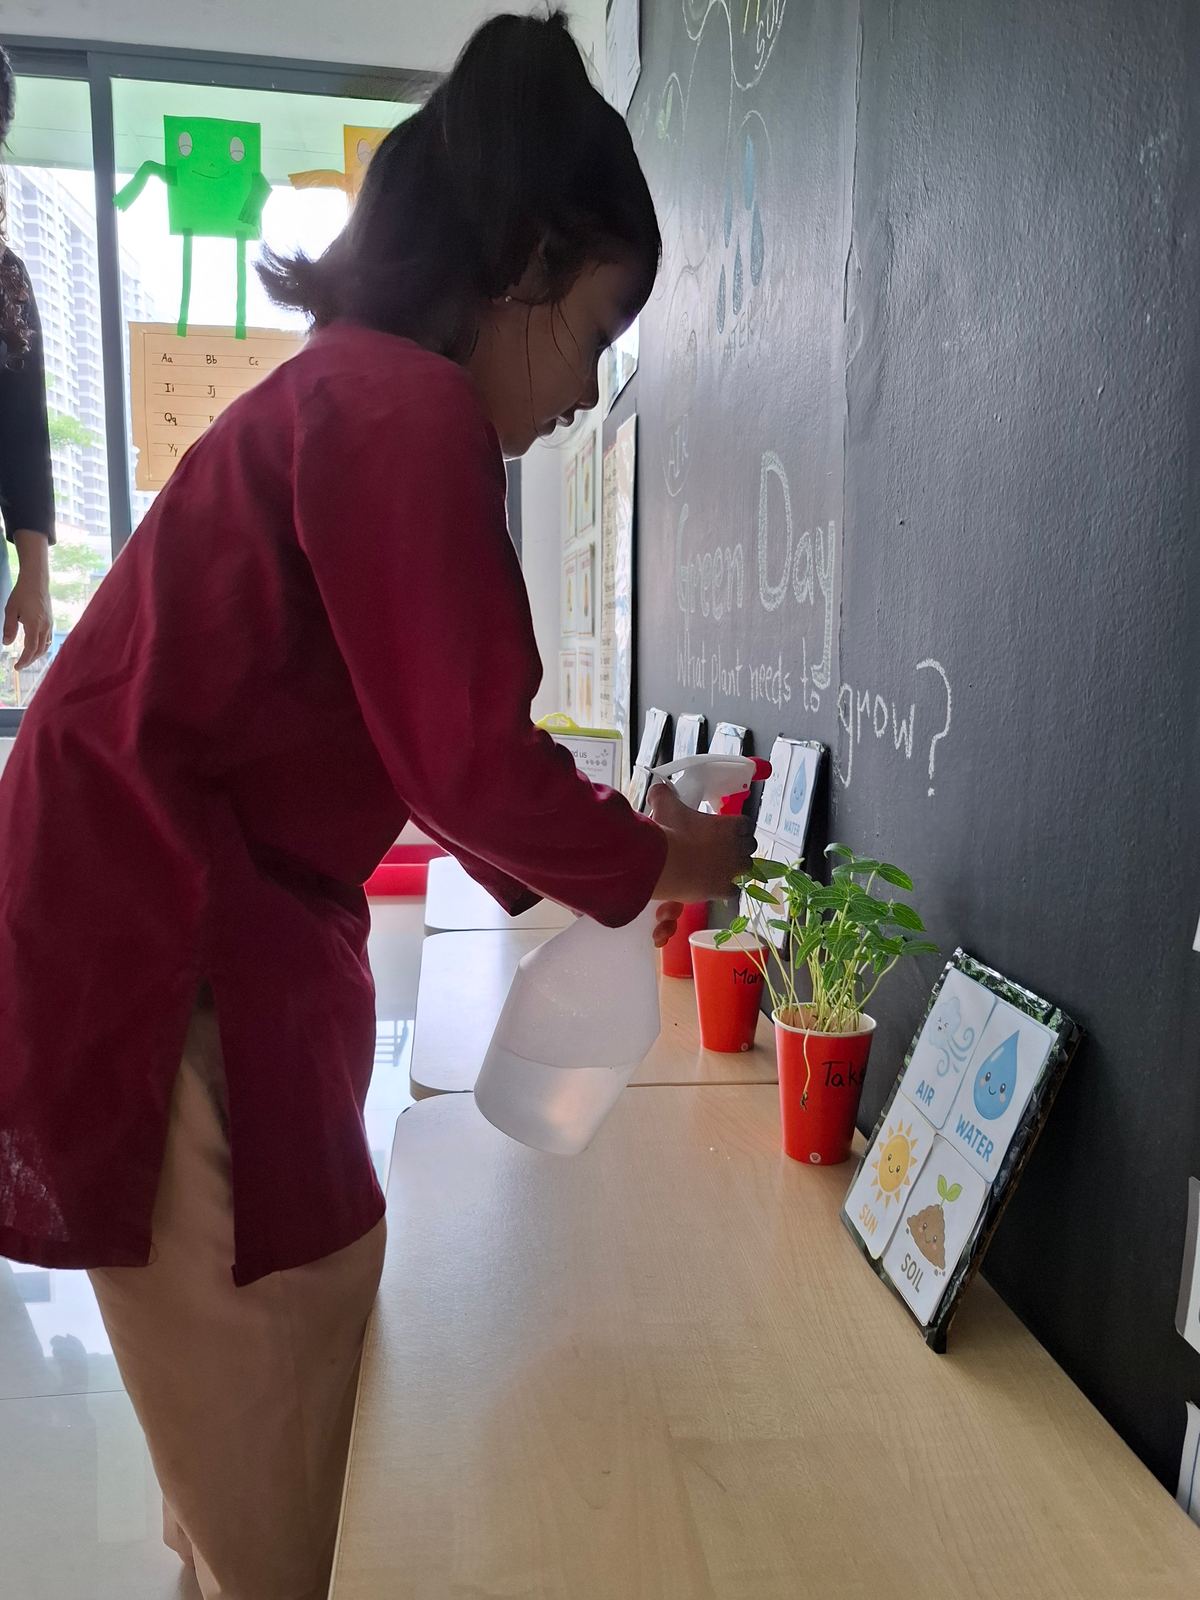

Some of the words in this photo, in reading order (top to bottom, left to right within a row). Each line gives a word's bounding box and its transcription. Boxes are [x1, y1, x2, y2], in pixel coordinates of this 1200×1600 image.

[161, 353, 173, 364] Aa
[205, 354, 218, 365] Bb
[248, 357, 259, 366] Cc
[164, 383, 175, 393] Ii
[207, 385, 216, 398] Jj
[164, 412, 178, 426] Qq
[167, 443, 178, 456] Yy
[676, 503, 744, 631] Green
[758, 450, 836, 689] Day
[710, 644, 743, 708] plant
[749, 651, 792, 711] needs
[800, 637, 820, 712] to
[838, 658, 952, 797] grow?
[915, 1079, 936, 1107] AIR
[955, 1113, 995, 1163] WATER
[858, 1205, 879, 1236] SUN
[900, 1253, 925, 1294] SOIL
